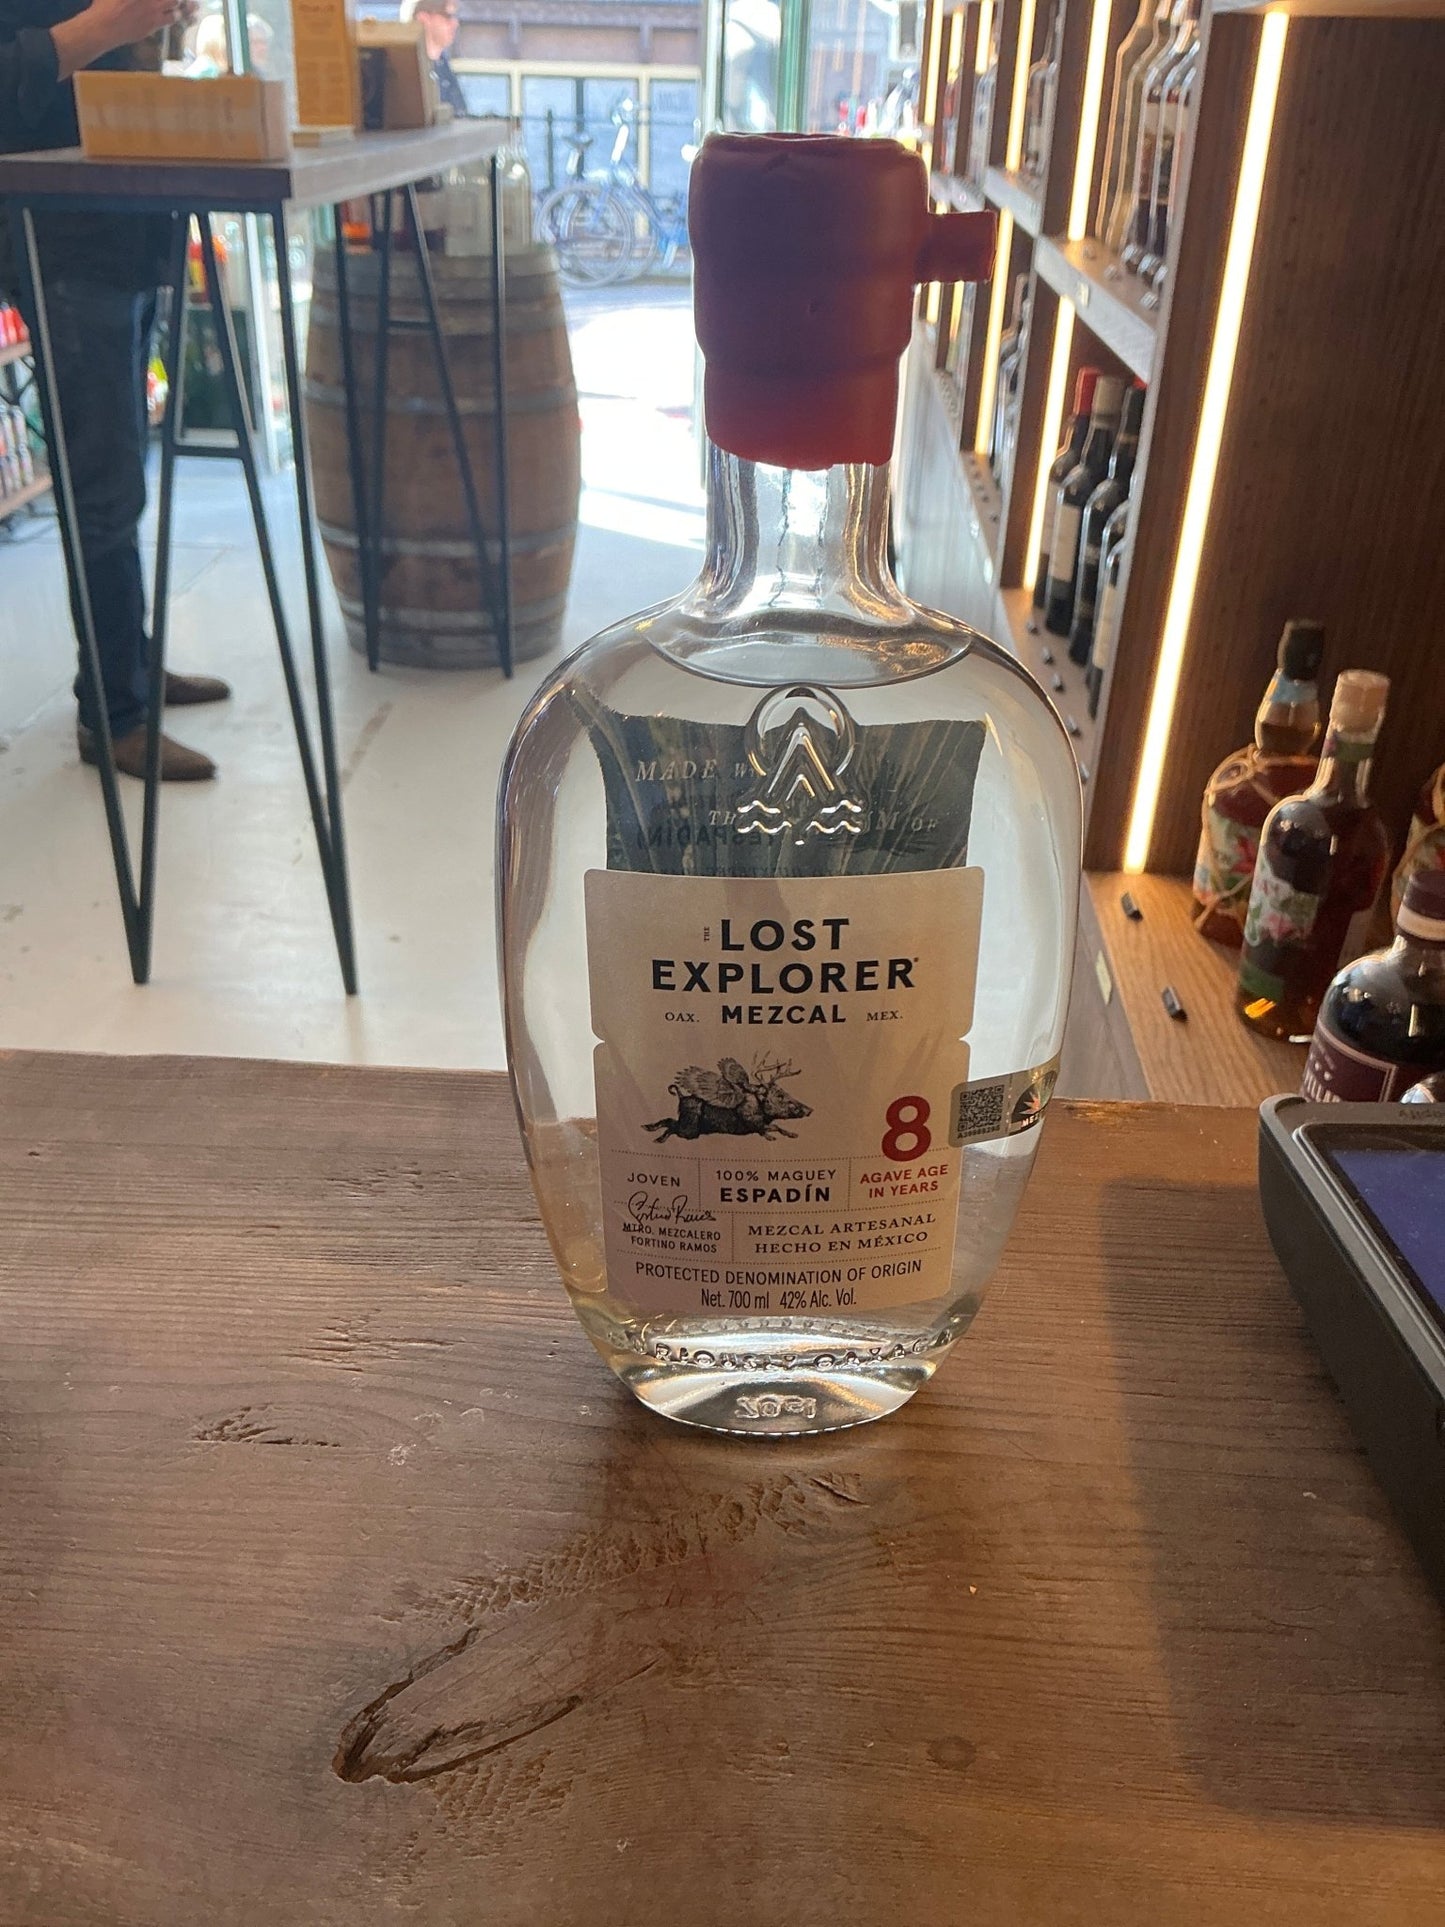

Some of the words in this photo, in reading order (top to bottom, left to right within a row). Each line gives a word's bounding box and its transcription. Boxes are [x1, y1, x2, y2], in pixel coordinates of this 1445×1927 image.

[635, 759, 717, 782] MADE
[721, 918, 849, 951] LOST
[652, 958, 915, 994] EXPLORER
[665, 1011, 700, 1022] OAX.
[722, 1004, 846, 1025] MEZCAL
[866, 1010, 903, 1021] MEX.
[882, 1095, 932, 1162] 8
[627, 1172, 680, 1187] JOVEN
[716, 1170, 759, 1182] 100%
[768, 1169, 837, 1182] MAGUEY
[860, 1169, 912, 1184] AGAVE
[917, 1164, 948, 1178] AGE
[720, 1184, 830, 1203] ESPADÍN
[869, 1187, 884, 1198] IN
[890, 1181, 939, 1196] YEARS
[658, 1227, 721, 1241] MEZCALERO
[748, 1224, 824, 1236] MEZCAL
[830, 1213, 936, 1234] ARTESANAL
[631, 1236, 676, 1250] FORTINO
[679, 1242, 717, 1253] RAMOS
[755, 1242, 821, 1254] HECHO
[828, 1240, 851, 1251] EN
[858, 1231, 928, 1249] MÉXICO
[635, 1261, 720, 1284] PROTECTED
[725, 1269, 842, 1285] DENOMINATION
[847, 1266, 867, 1281] OF
[871, 1259, 922, 1279] ORIGIN
[701, 1288, 725, 1308] Net.
[728, 1290, 750, 1309] 700
[754, 1291, 769, 1309] ml
[779, 1290, 807, 1309] 42%
[809, 1289, 832, 1309] Alc.
[835, 1287, 857, 1306] Vol.
